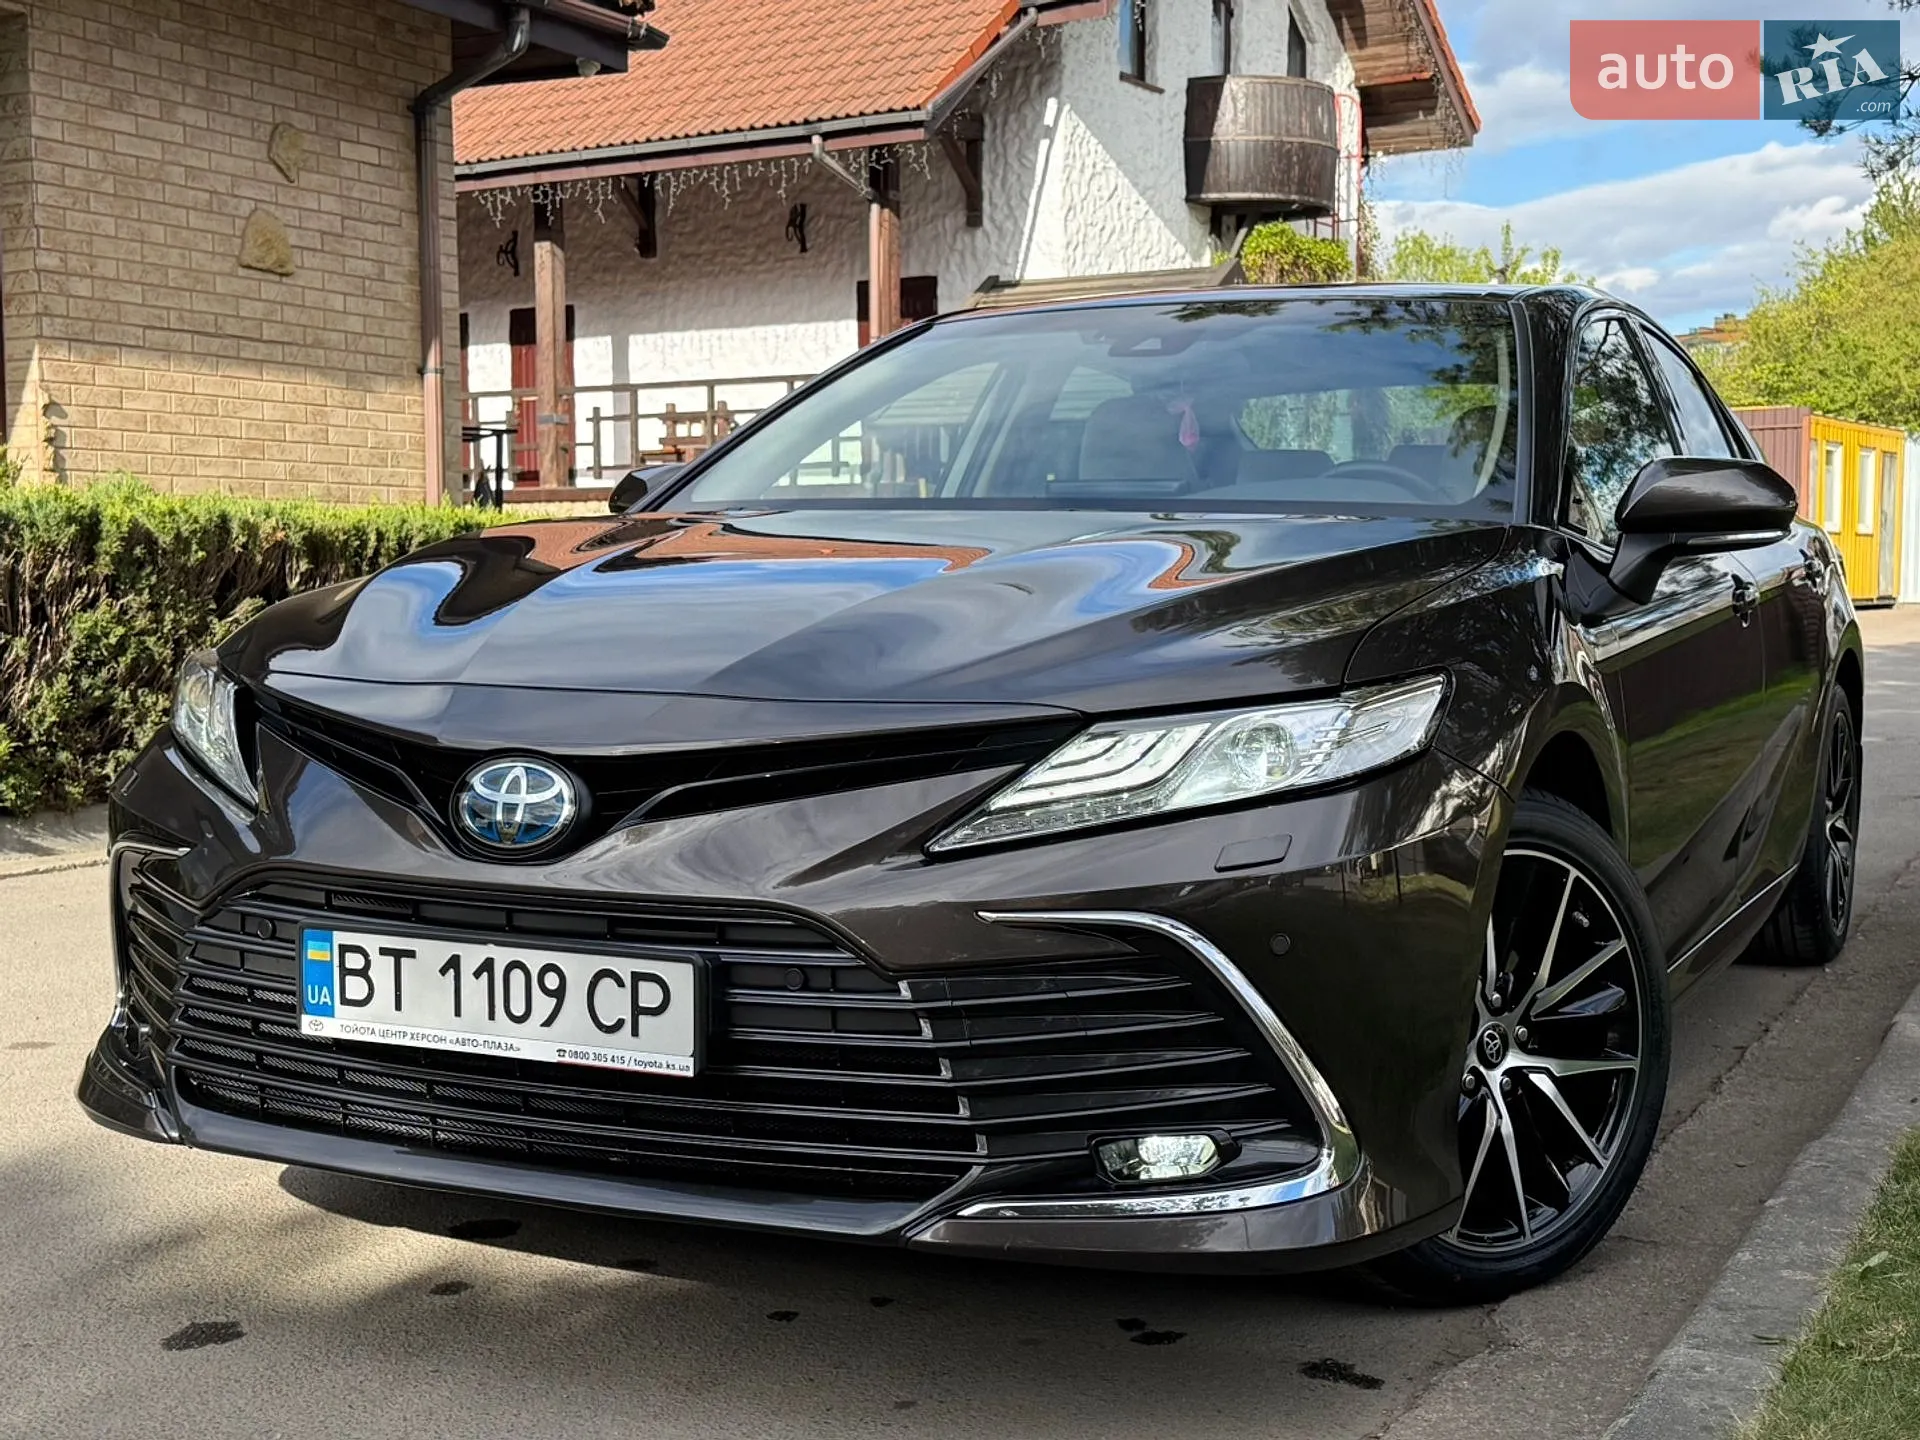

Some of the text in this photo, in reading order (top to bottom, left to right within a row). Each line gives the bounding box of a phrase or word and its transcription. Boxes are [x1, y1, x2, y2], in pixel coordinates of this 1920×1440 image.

[307, 984, 332, 1006] UA
[337, 943, 672, 1038] BT 1109 CP
[339, 1023, 377, 1037] ТОЙОТА
[378, 1028, 408, 1041] ЦЕНТР
[409, 1031, 448, 1045] ХЕРСОН
[567, 1049, 590, 1061] 0800
[592, 1052, 608, 1063] 305
[610, 1054, 625, 1065] 415
[633, 1057, 691, 1072] toyota.ks.ua
